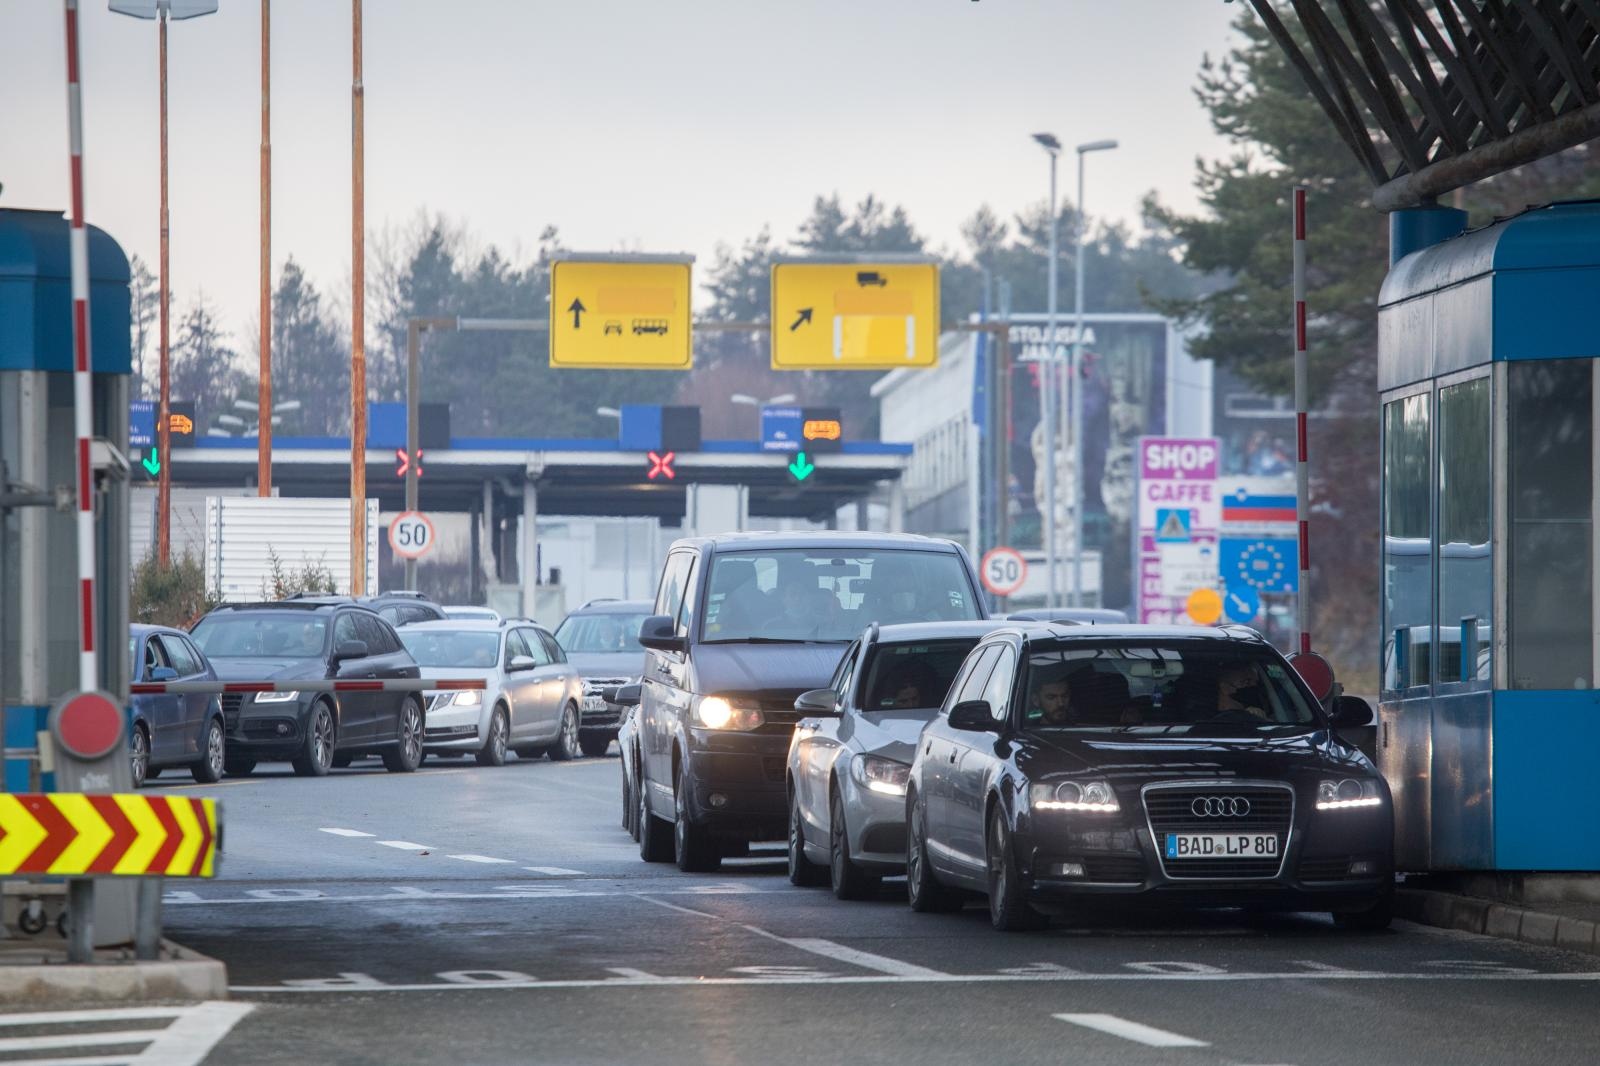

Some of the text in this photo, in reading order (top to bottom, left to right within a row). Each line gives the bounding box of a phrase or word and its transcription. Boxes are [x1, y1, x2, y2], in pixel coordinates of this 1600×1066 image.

[1146, 445, 1216, 471] SHOP
[1148, 484, 1212, 502] CAFFE
[399, 523, 427, 546] 50
[990, 558, 1018, 583] 50
[1178, 836, 1214, 855] BAD
[1226, 836, 1250, 855] LP
[1254, 836, 1276, 855] 80
